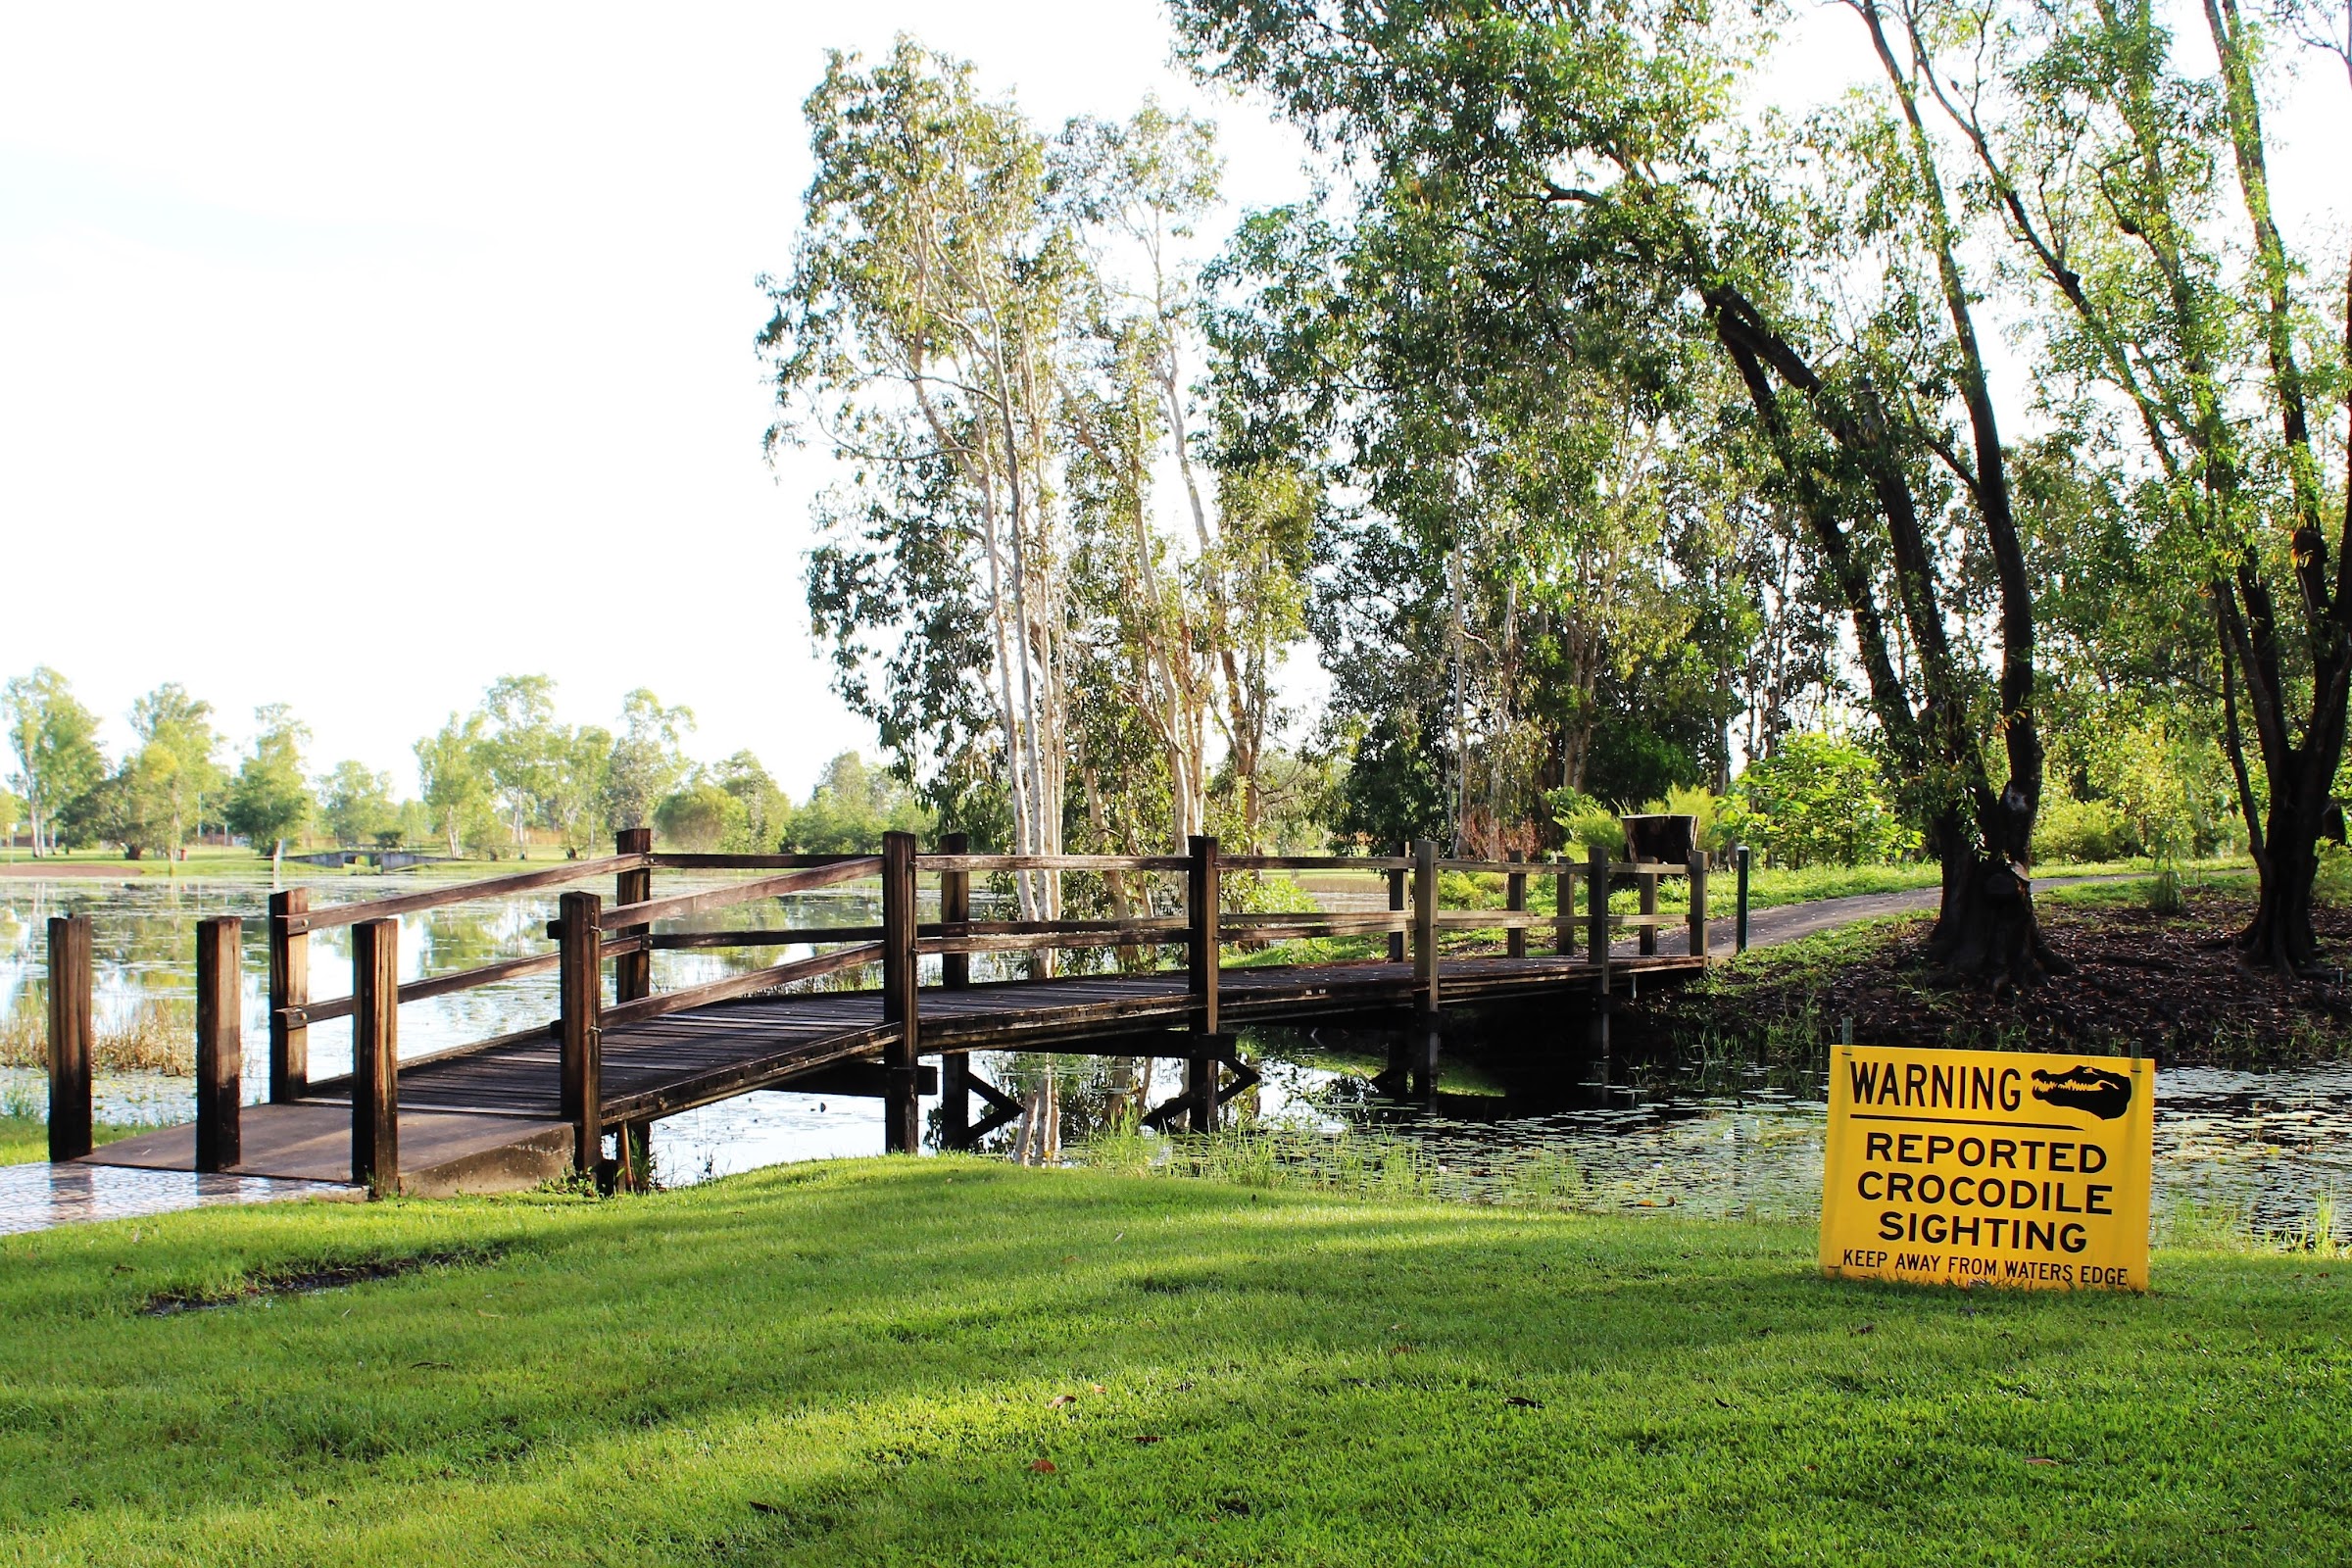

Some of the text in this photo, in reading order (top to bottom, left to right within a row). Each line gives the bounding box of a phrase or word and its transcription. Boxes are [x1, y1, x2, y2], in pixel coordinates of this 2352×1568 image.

[1850, 1061, 2021, 1111] WARNING
[1866, 1132, 2107, 1174] REPORTED
[1858, 1171, 2113, 1215] CROCODILE
[1878, 1211, 2087, 1253] SIGHTING
[1843, 1250, 2128, 1286] KEEP AWAY FROM WATERS EDGE
